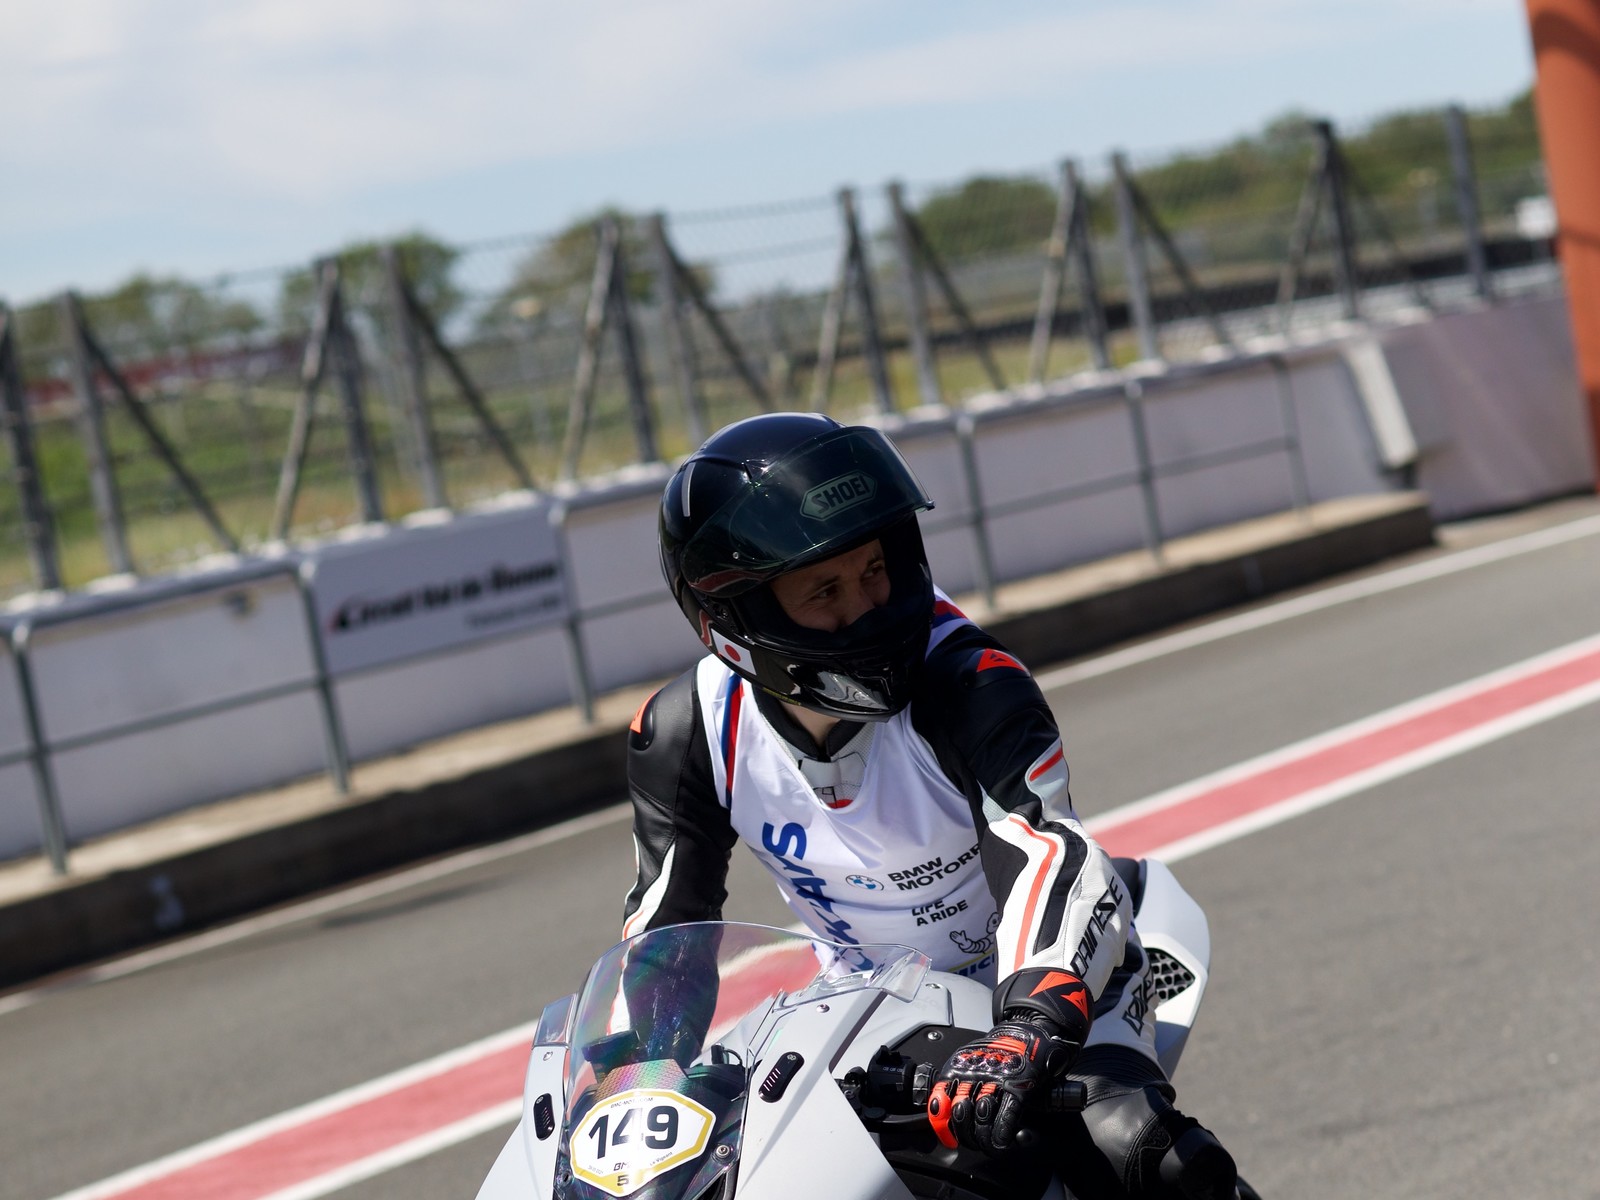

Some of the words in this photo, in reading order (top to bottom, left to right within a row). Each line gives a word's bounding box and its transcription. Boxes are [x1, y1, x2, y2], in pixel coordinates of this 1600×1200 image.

[810, 475, 870, 514] SHOEI
[888, 857, 943, 882] BMW
[916, 917, 928, 927] A
[930, 900, 969, 923] RIDE
[1070, 876, 1123, 980] DAINESE
[588, 1105, 679, 1160] 149
[616, 1173, 630, 1187] 5
